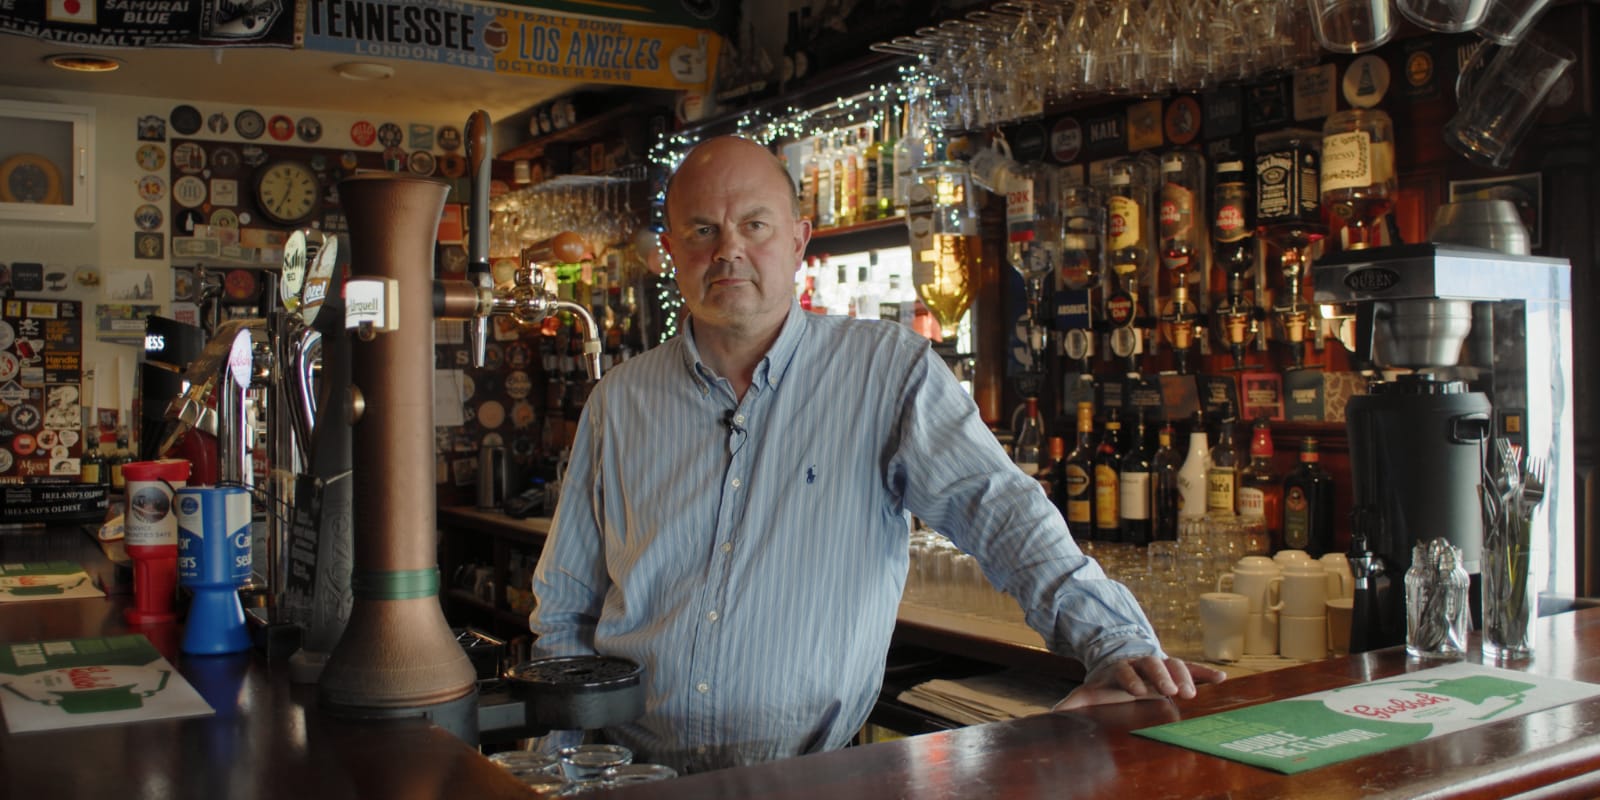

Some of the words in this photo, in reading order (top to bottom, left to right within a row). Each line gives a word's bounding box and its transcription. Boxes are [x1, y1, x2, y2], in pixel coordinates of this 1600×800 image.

[103, 0, 190, 13] SAMURAI
[122, 13, 171, 25] BLUE
[310, 0, 476, 52] TENNESSEE
[578, 18, 623, 34] BOWL
[519, 23, 561, 64] LOS
[567, 32, 662, 71] ANGELES
[355, 42, 439, 60] LONDON
[447, 51, 492, 68] 21ST
[496, 58, 586, 78] OCTOBER
[1350, 271, 1394, 291] QUEEN
[1219, 730, 1308, 752] DOUBLE
